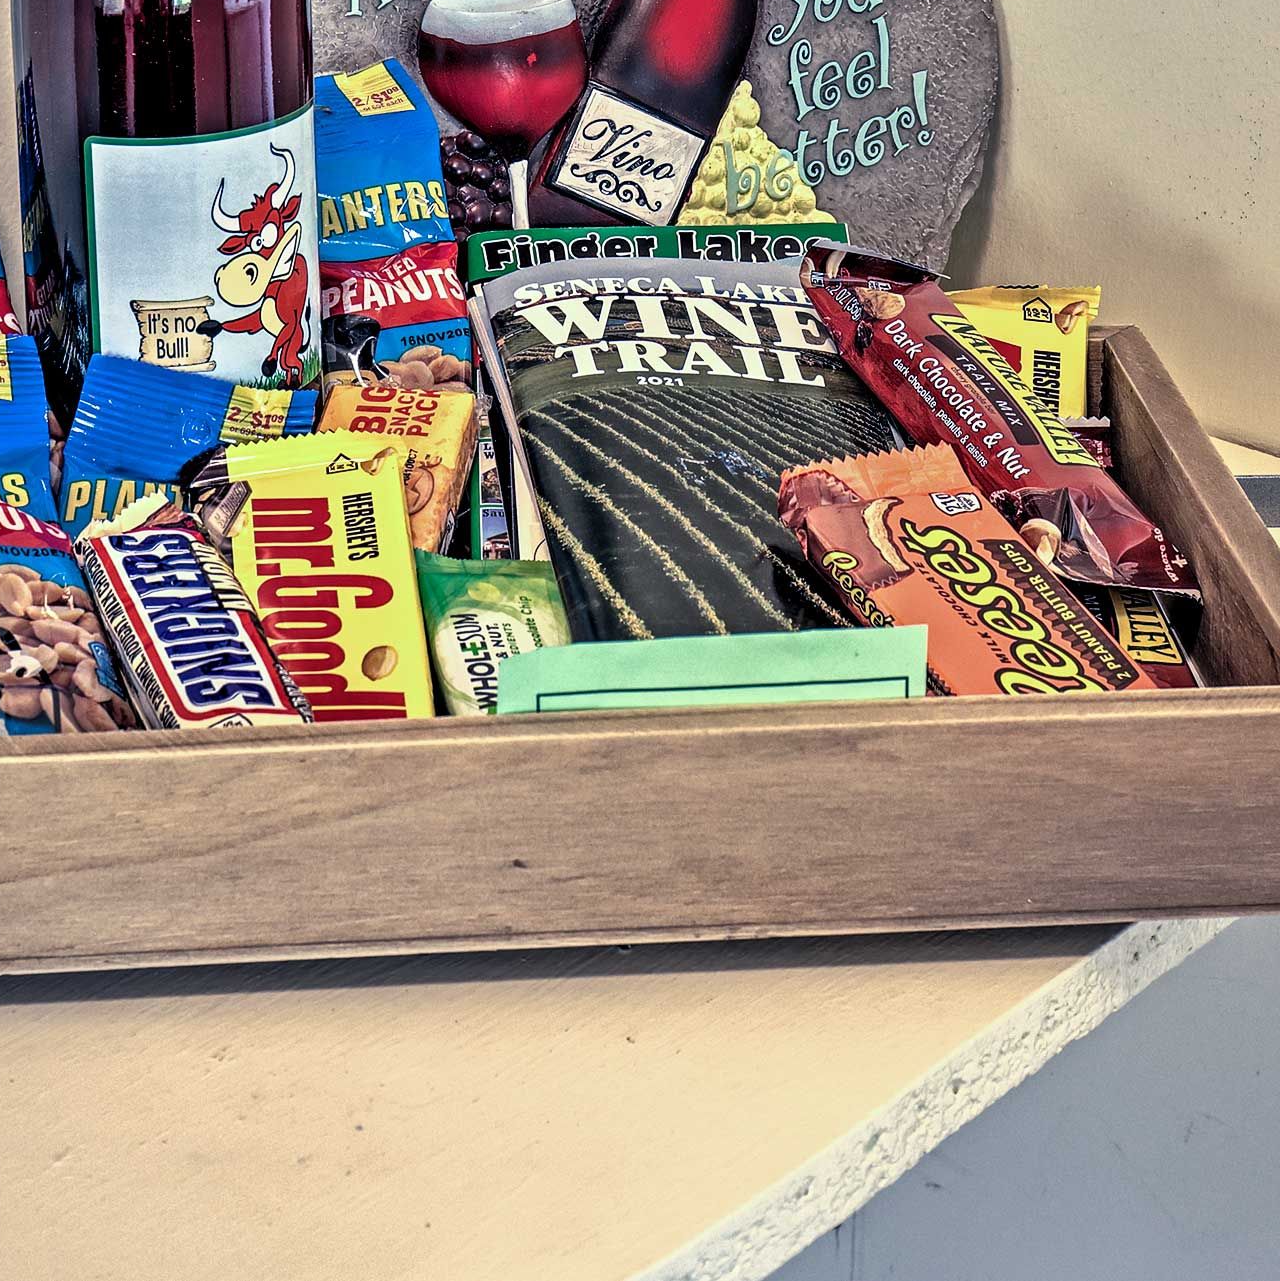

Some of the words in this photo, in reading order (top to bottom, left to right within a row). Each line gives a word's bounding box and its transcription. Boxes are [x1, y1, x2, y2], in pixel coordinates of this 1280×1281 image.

[787, 11, 893, 122] feel
[581, 117, 677, 183] Vino
[723, 70, 936, 217] better!
[322, 180, 449, 238] ANTERS
[352, 256, 418, 280] SALTED
[481, 229, 658, 272] Finger
[321, 268, 466, 319] PEANUTS
[514, 275, 685, 309] SENECA
[147, 313, 171, 335] It's
[174, 315, 197, 333] no
[156, 337, 190, 359] Bull!
[514, 293, 839, 355] WINE
[556, 339, 826, 388] TRAIL
[636, 375, 685, 388] 2021
[1032, 350, 1061, 418] HERSHEY
[347, 386, 404, 433] BIG
[884, 319, 924, 360] Dark
[919, 357, 987, 433] Chocolate
[983, 431, 1004, 449] &
[996, 446, 1031, 480] Nut
[892, 358, 910, 378] dark
[935, 408, 963, 439] peanuts
[959, 434, 970, 446] &
[965, 443, 989, 468] raisins
[940, 320, 1027, 392] NATURE
[1021, 390, 1098, 464] VALLEY
[955, 354, 996, 395] TRAIL
[995, 399, 1024, 426] MIX
[342, 492, 380, 562] HERSHEY'S
[999, 542, 1033, 574] CUPS
[100, 589, 120, 620] MILK
[519, 595, 533, 616] Chip
[822, 551, 896, 628] Reese'
[913, 560, 978, 627] CHOCOLATE
[1028, 574, 1078, 621] BUTTER
[108, 533, 276, 708] SNICKERS
[502, 622, 521, 655] EDIENTS
[524, 617, 543, 648] ocolate
[1120, 591, 1178, 660] ALLEY
[977, 631, 1012, 665] MILK
[1069, 622, 1122, 671] PEANUT
[1116, 670, 1132, 681] 2
